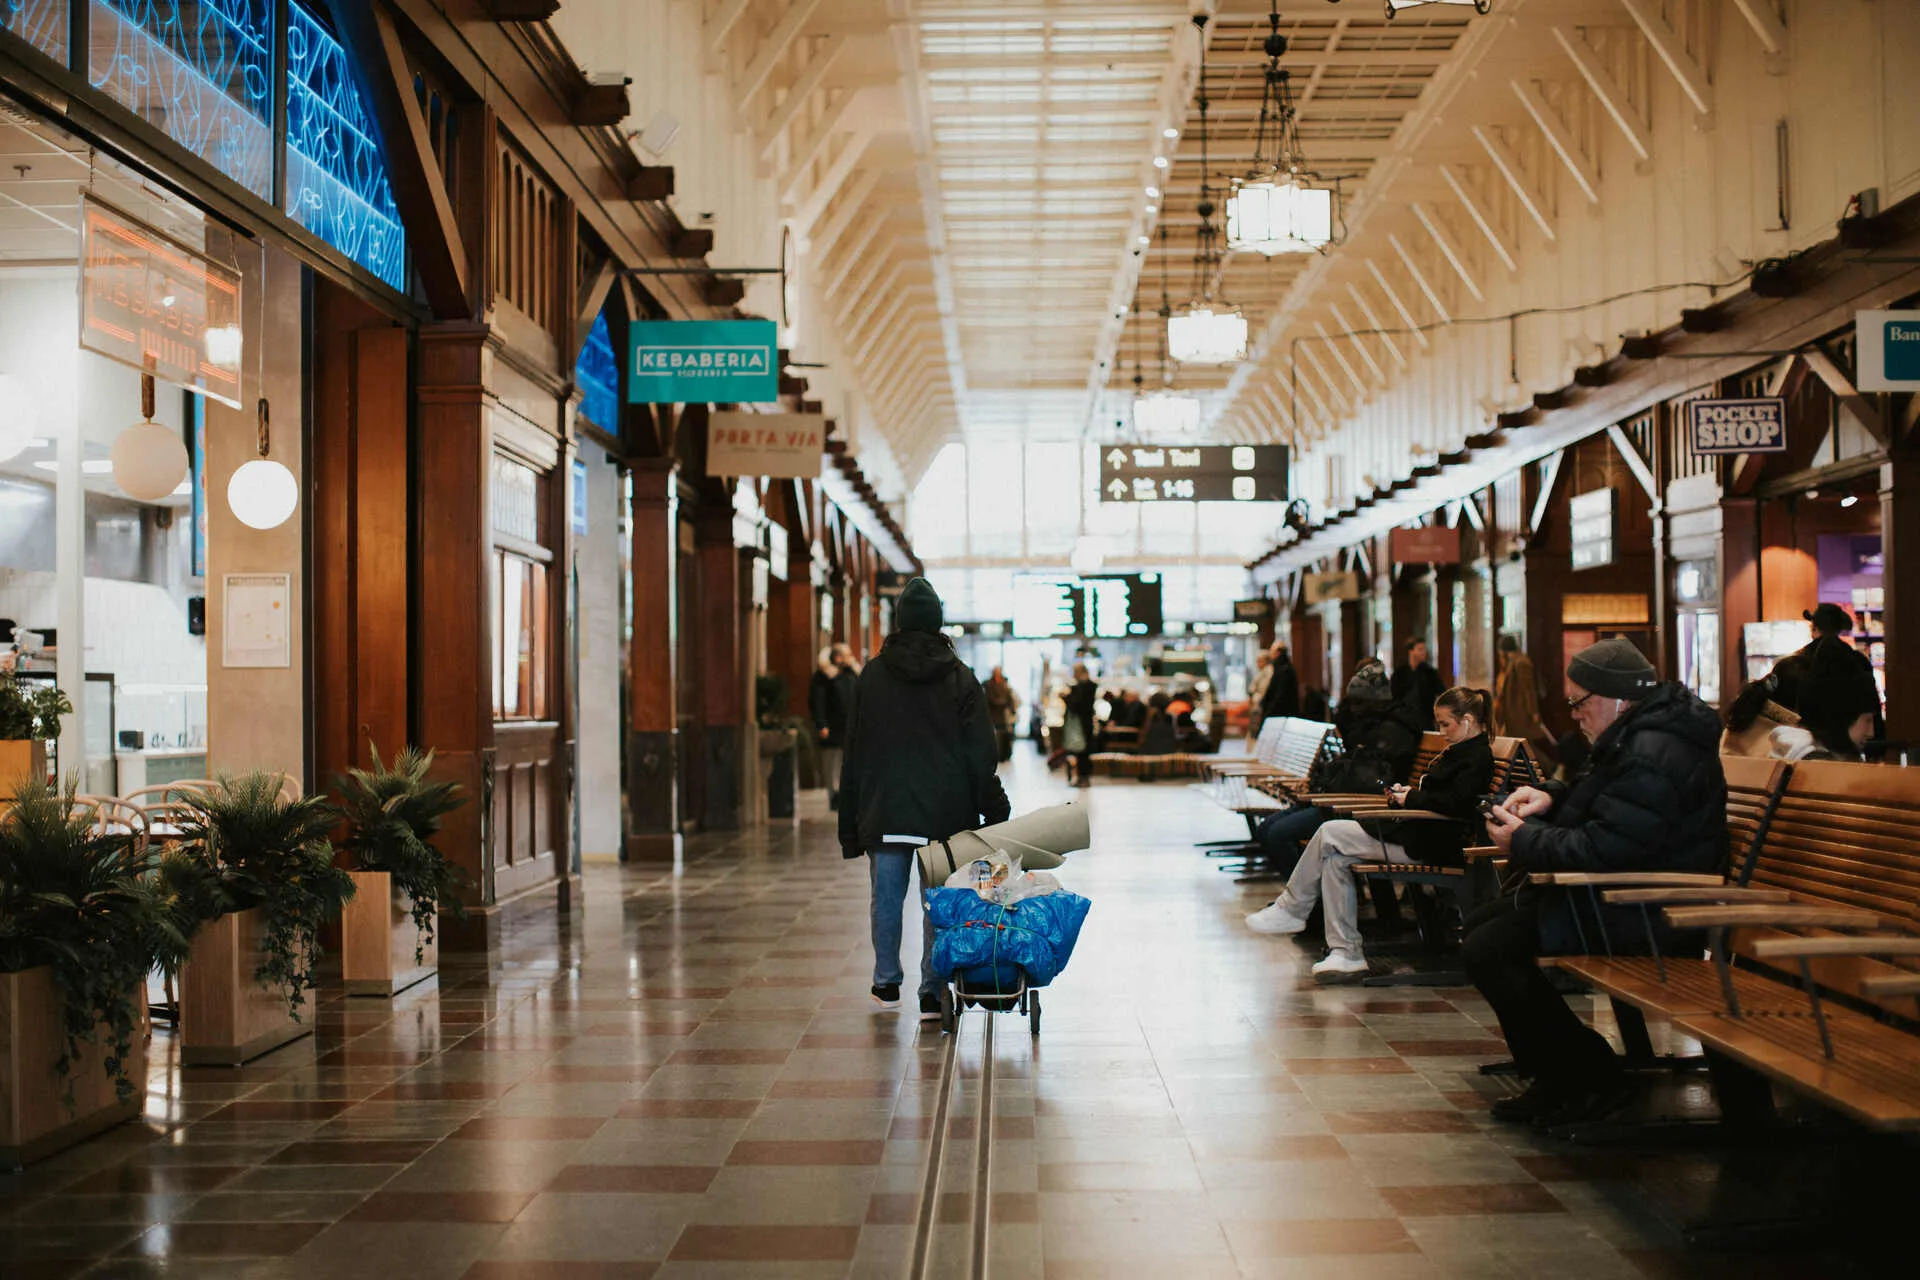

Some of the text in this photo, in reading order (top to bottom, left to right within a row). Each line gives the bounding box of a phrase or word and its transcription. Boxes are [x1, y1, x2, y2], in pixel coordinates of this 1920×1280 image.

[642, 352, 763, 368] KEBABERIA
[1698, 405, 1778, 421] POCKET
[785, 430, 818, 447] VIA
[1698, 421, 1779, 448] SHOP
